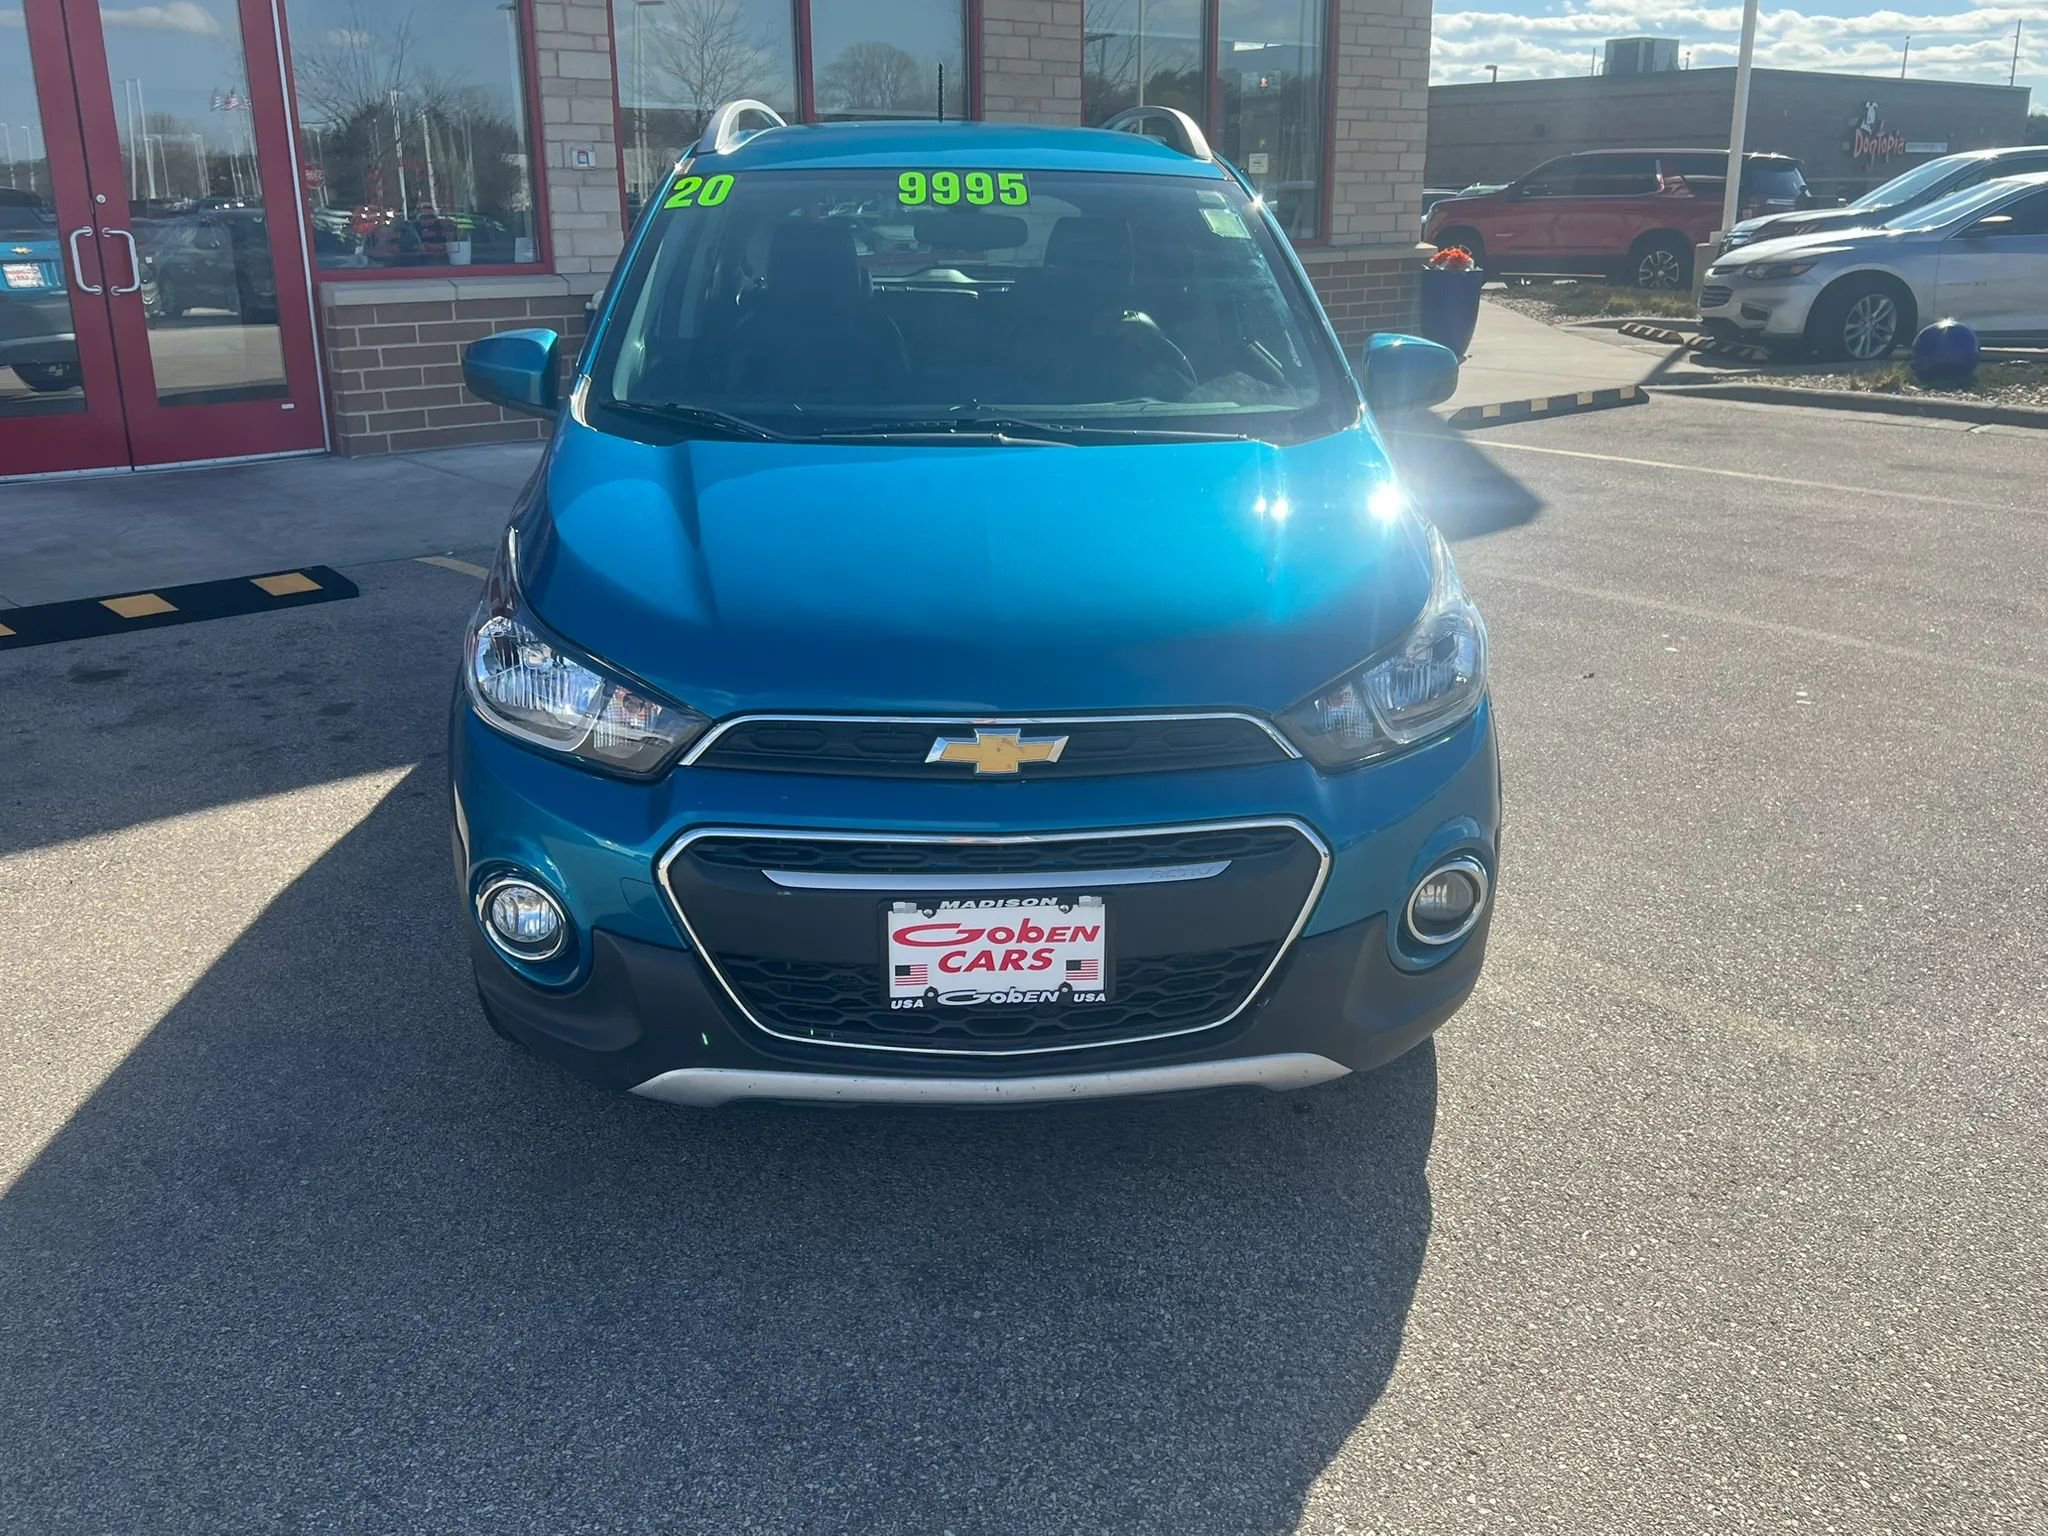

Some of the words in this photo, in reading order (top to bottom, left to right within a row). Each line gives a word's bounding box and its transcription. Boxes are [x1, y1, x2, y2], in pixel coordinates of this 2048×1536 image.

[663, 173, 736, 209] 20
[898, 171, 1029, 206] 9995
[939, 897, 1058, 910] MADISON
[937, 947, 1056, 974] CARS
[890, 999, 924, 1010] USA
[1073, 992, 1107, 1003] USA
